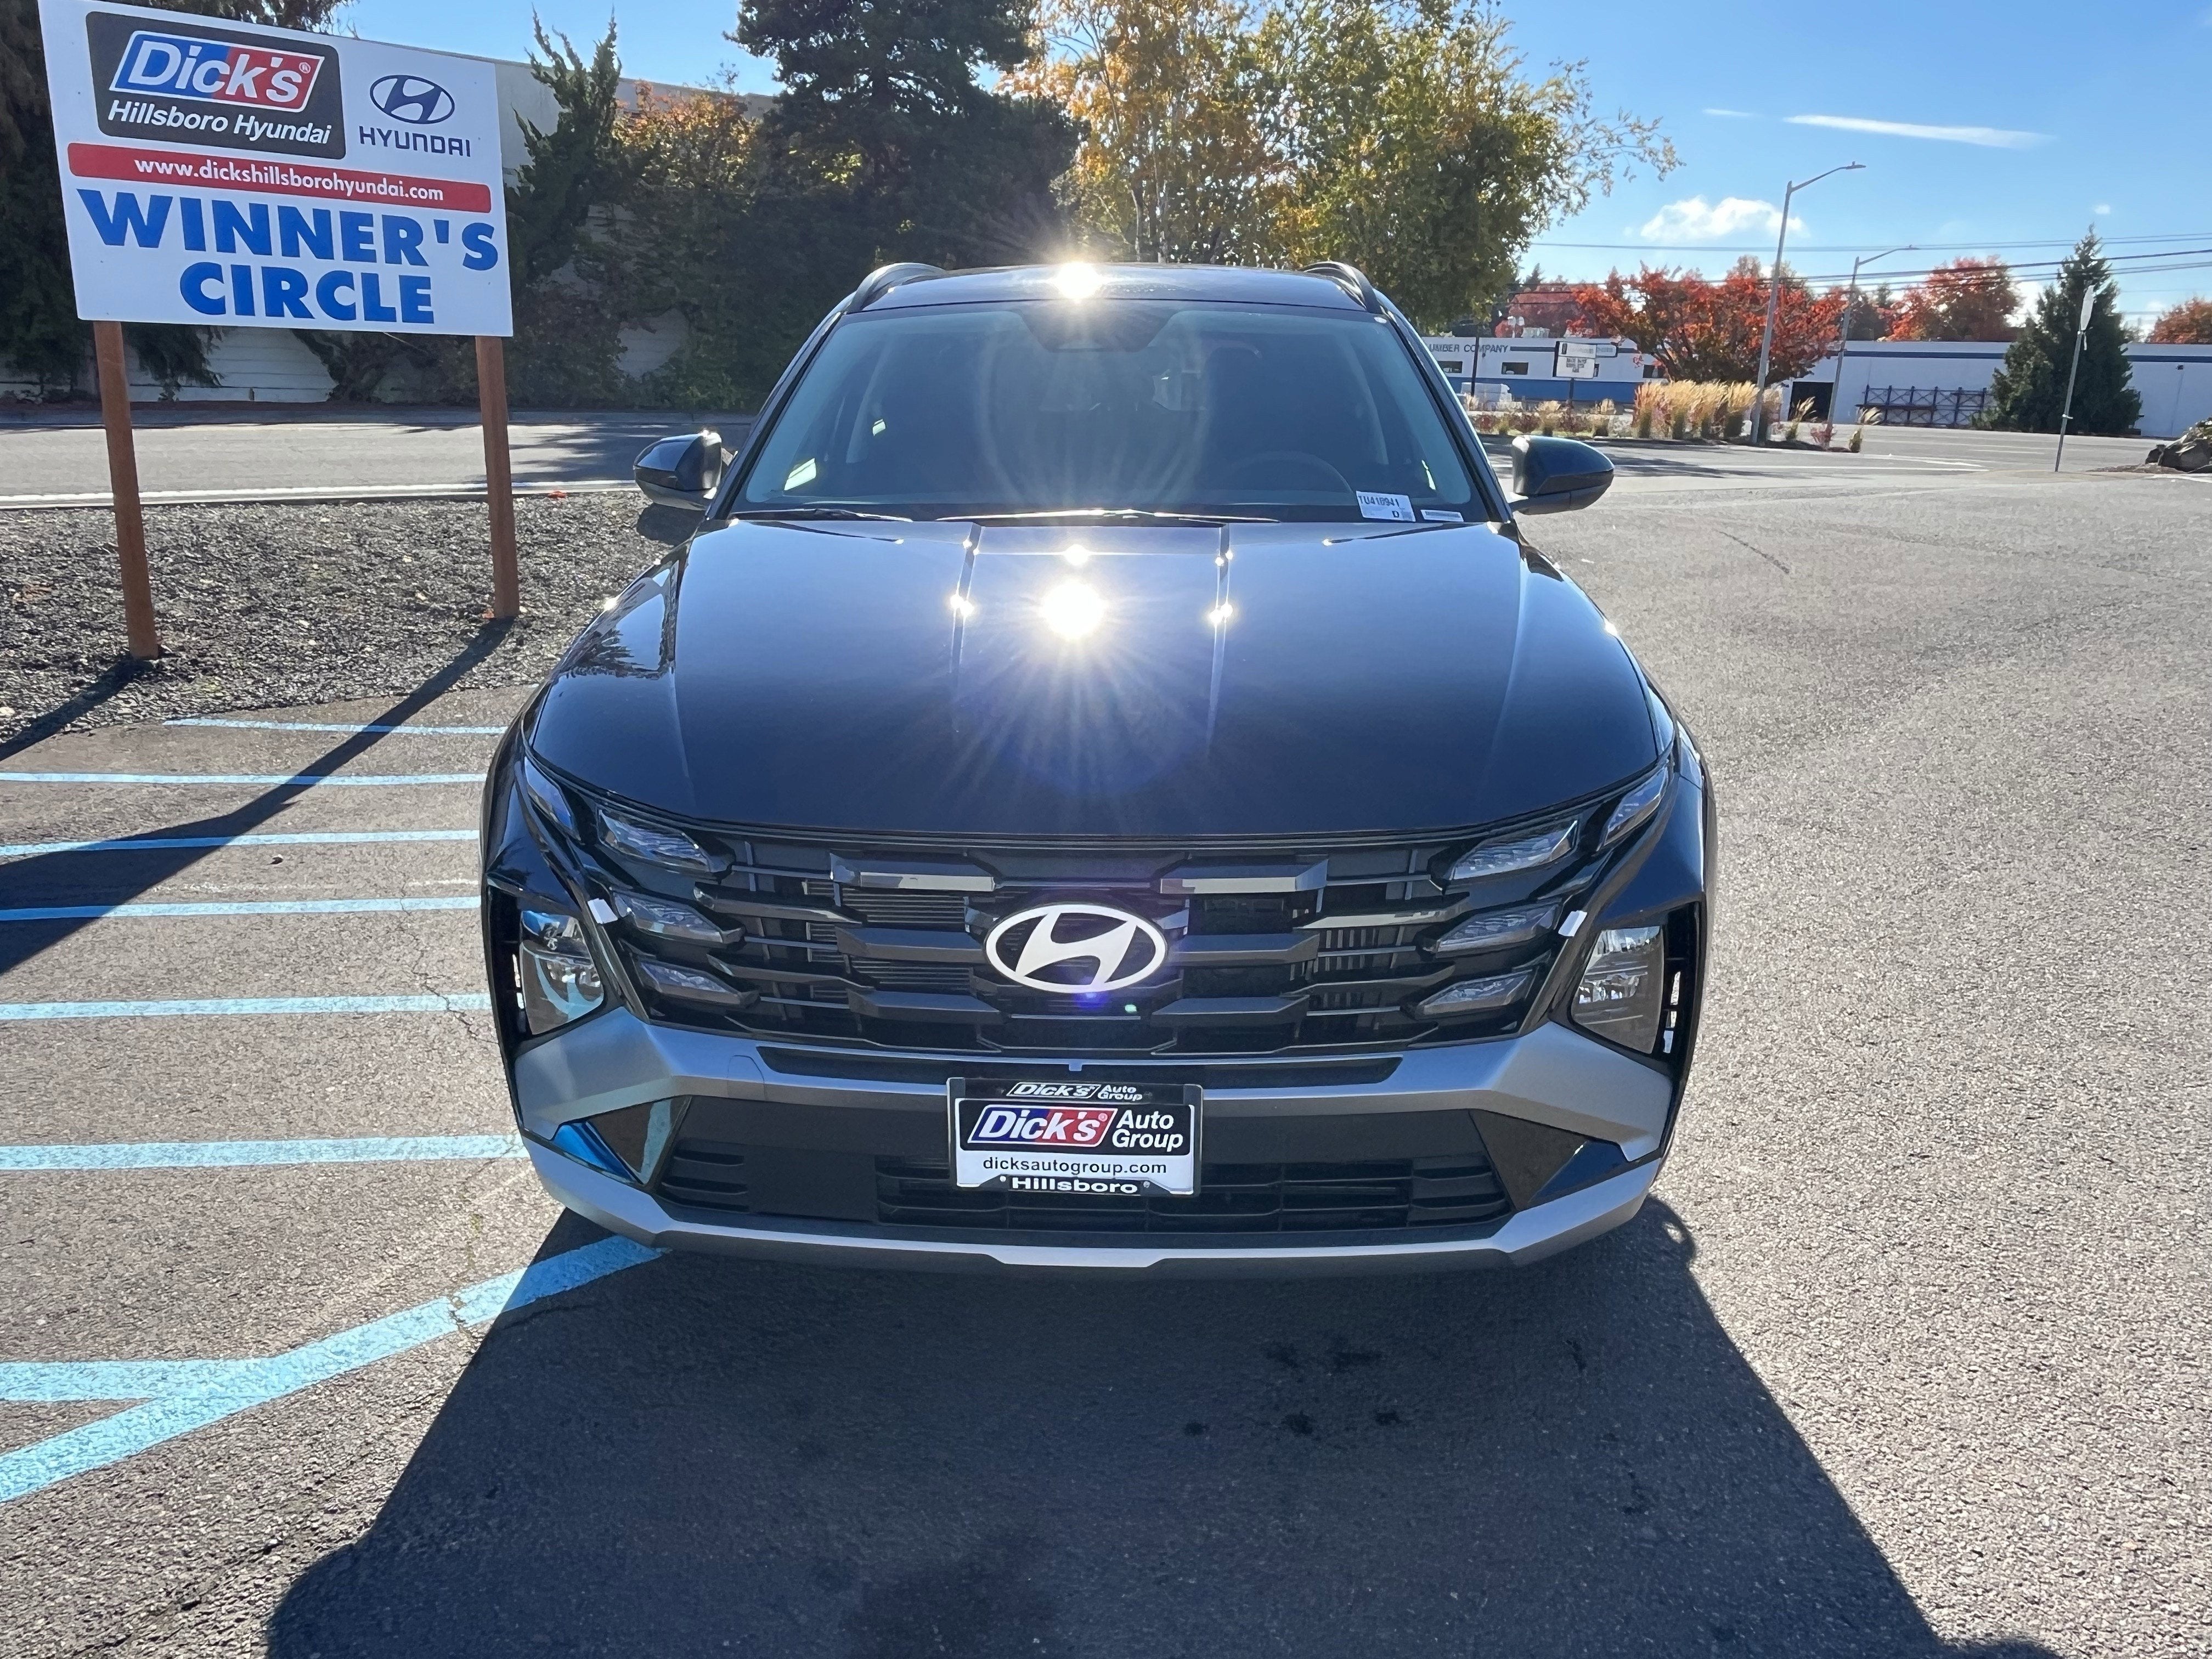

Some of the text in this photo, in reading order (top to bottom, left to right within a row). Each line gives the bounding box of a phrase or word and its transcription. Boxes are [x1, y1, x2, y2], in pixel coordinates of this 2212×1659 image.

[128, 41, 302, 103] Dick's
[108, 100, 332, 144] Hillsboro Hyundai
[359, 126, 471, 157] HYUNDAI
[134, 159, 444, 201] www.dickshillsborohyundai.com
[76, 189, 499, 270] WINNER'S
[179, 262, 435, 324] CIRCLE
[1429, 344, 1509, 353] UMBER COMPANY
[1013, 1084, 1092, 1097] Dick's
[1097, 1091, 1143, 1102] Group
[1102, 1085, 1137, 1094] Auto
[978, 1109, 1101, 1142] Dick's
[1116, 1110, 1174, 1130] Auto
[1112, 1128, 1183, 1152] Group
[983, 1157, 1166, 1176] dicksautogroup.com
[1012, 1177, 1138, 1194] Hillsboro
